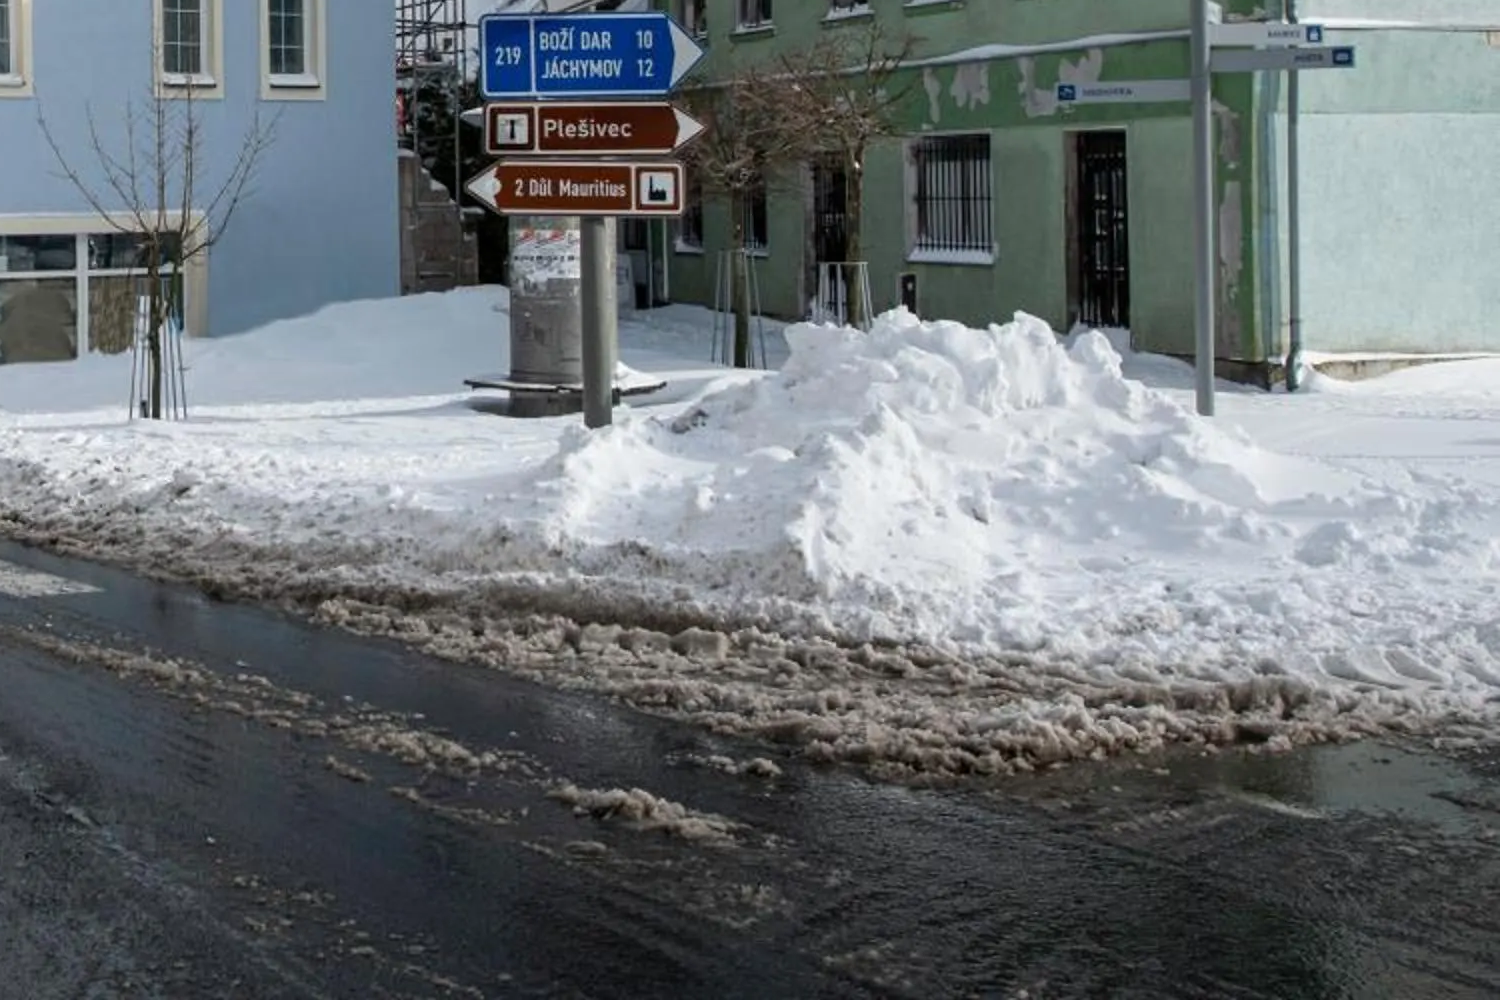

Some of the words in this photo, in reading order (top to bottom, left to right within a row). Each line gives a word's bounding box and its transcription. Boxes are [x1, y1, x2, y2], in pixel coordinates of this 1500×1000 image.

[539, 26, 575, 50] BOŽÍ
[580, 31, 612, 49] DAR
[636, 30, 654, 49] 10
[495, 47, 521, 66] 219
[541, 55, 623, 79] JÁCHYMOV
[637, 59, 654, 77] 12
[544, 117, 633, 138] Plešivec
[515, 180, 524, 197] 2
[529, 177, 553, 197] Důl
[559, 178, 627, 198] Mauritius
